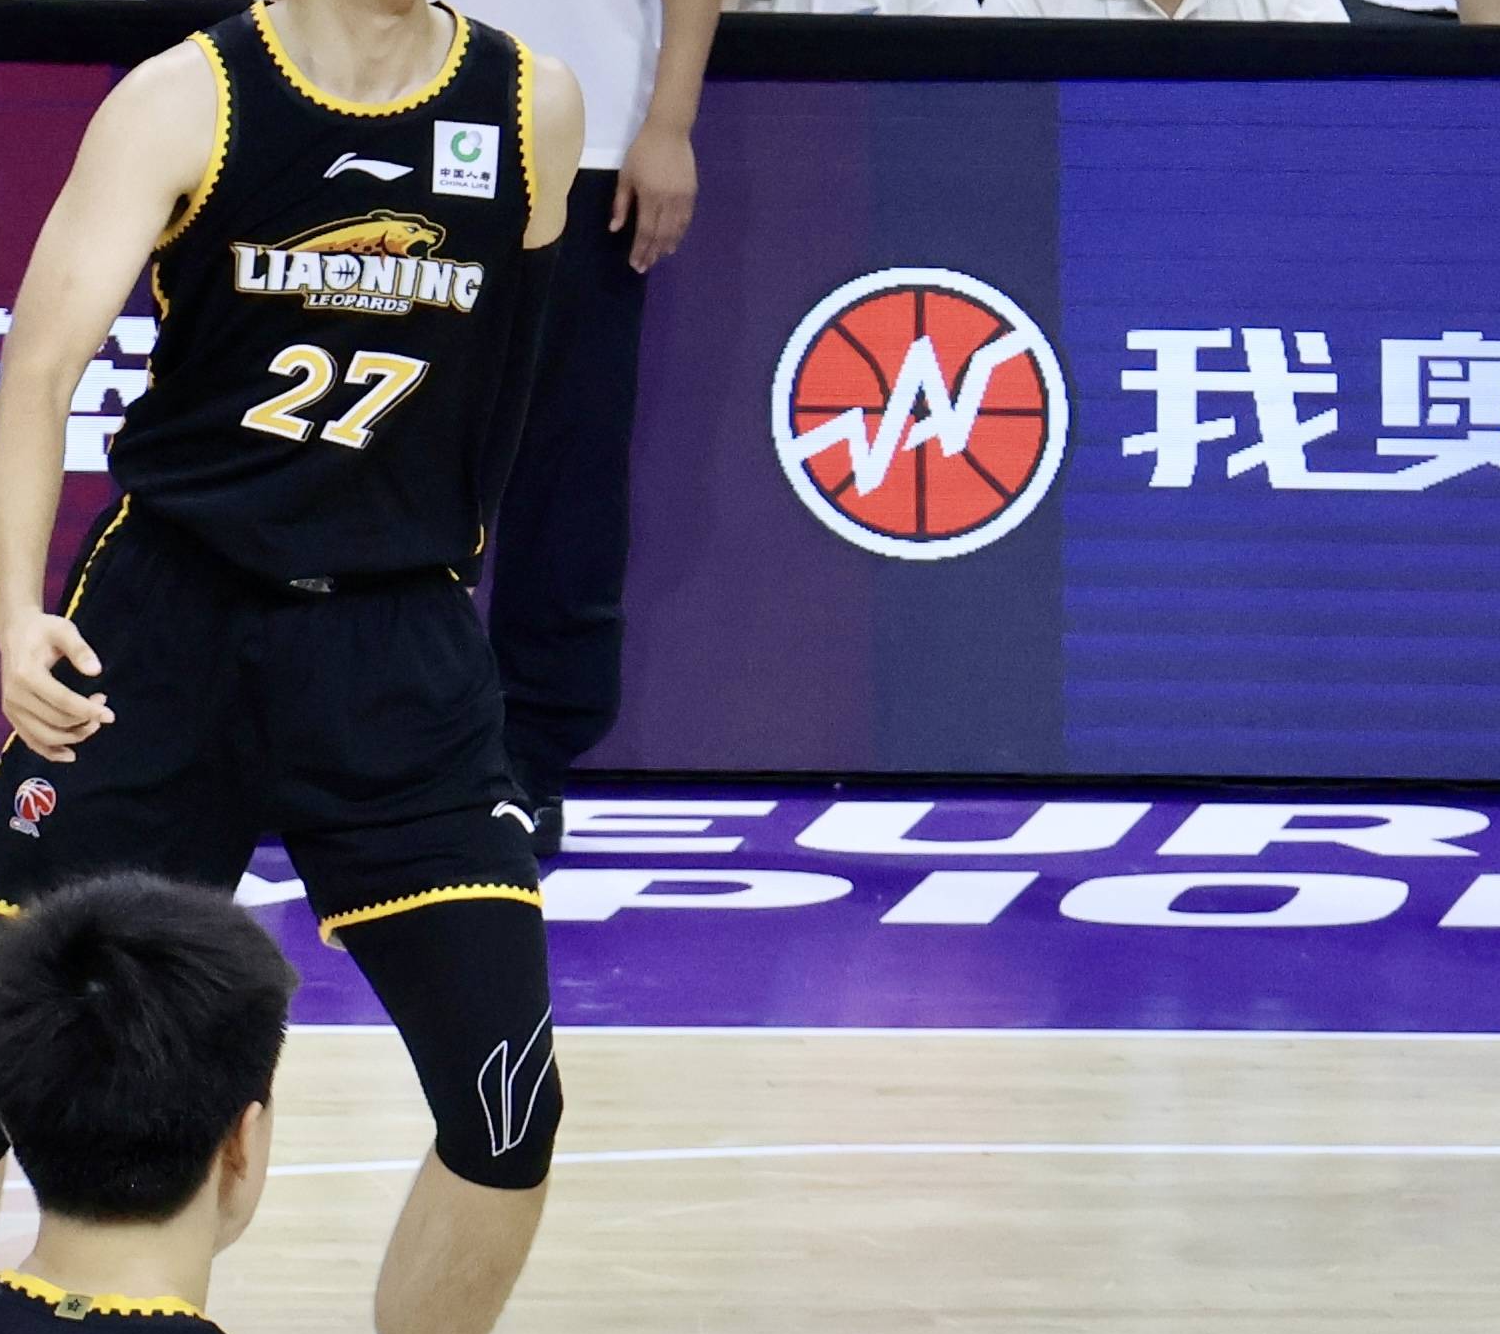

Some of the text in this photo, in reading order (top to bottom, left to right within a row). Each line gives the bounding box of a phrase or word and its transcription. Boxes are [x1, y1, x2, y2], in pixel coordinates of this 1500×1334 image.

[231, 243, 484, 313] LIAONING
[306, 290, 412, 315] LEOPARDS
[240, 343, 430, 450] 27
